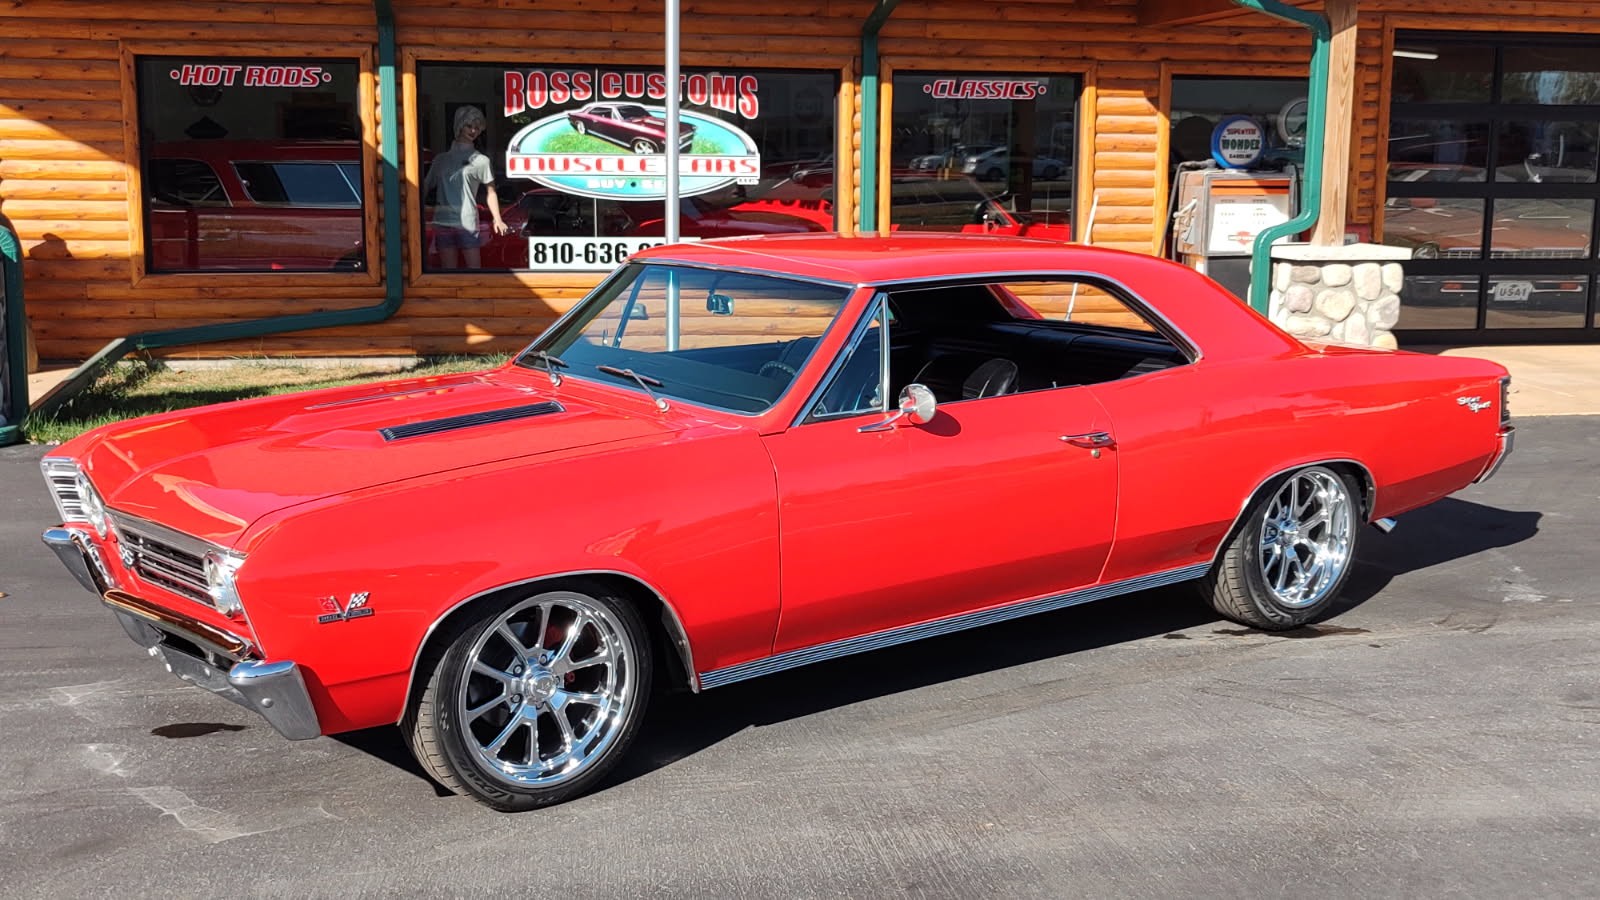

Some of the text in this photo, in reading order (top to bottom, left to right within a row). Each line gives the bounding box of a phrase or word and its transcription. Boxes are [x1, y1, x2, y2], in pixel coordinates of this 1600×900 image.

[180, 65, 322, 88] HOT RODS
[504, 71, 592, 117] ROSS
[931, 79, 1039, 100] CLASSICS
[509, 156, 658, 172] MUSCLE
[587, 178, 627, 189] BUY
[533, 242, 665, 264] 810-636
